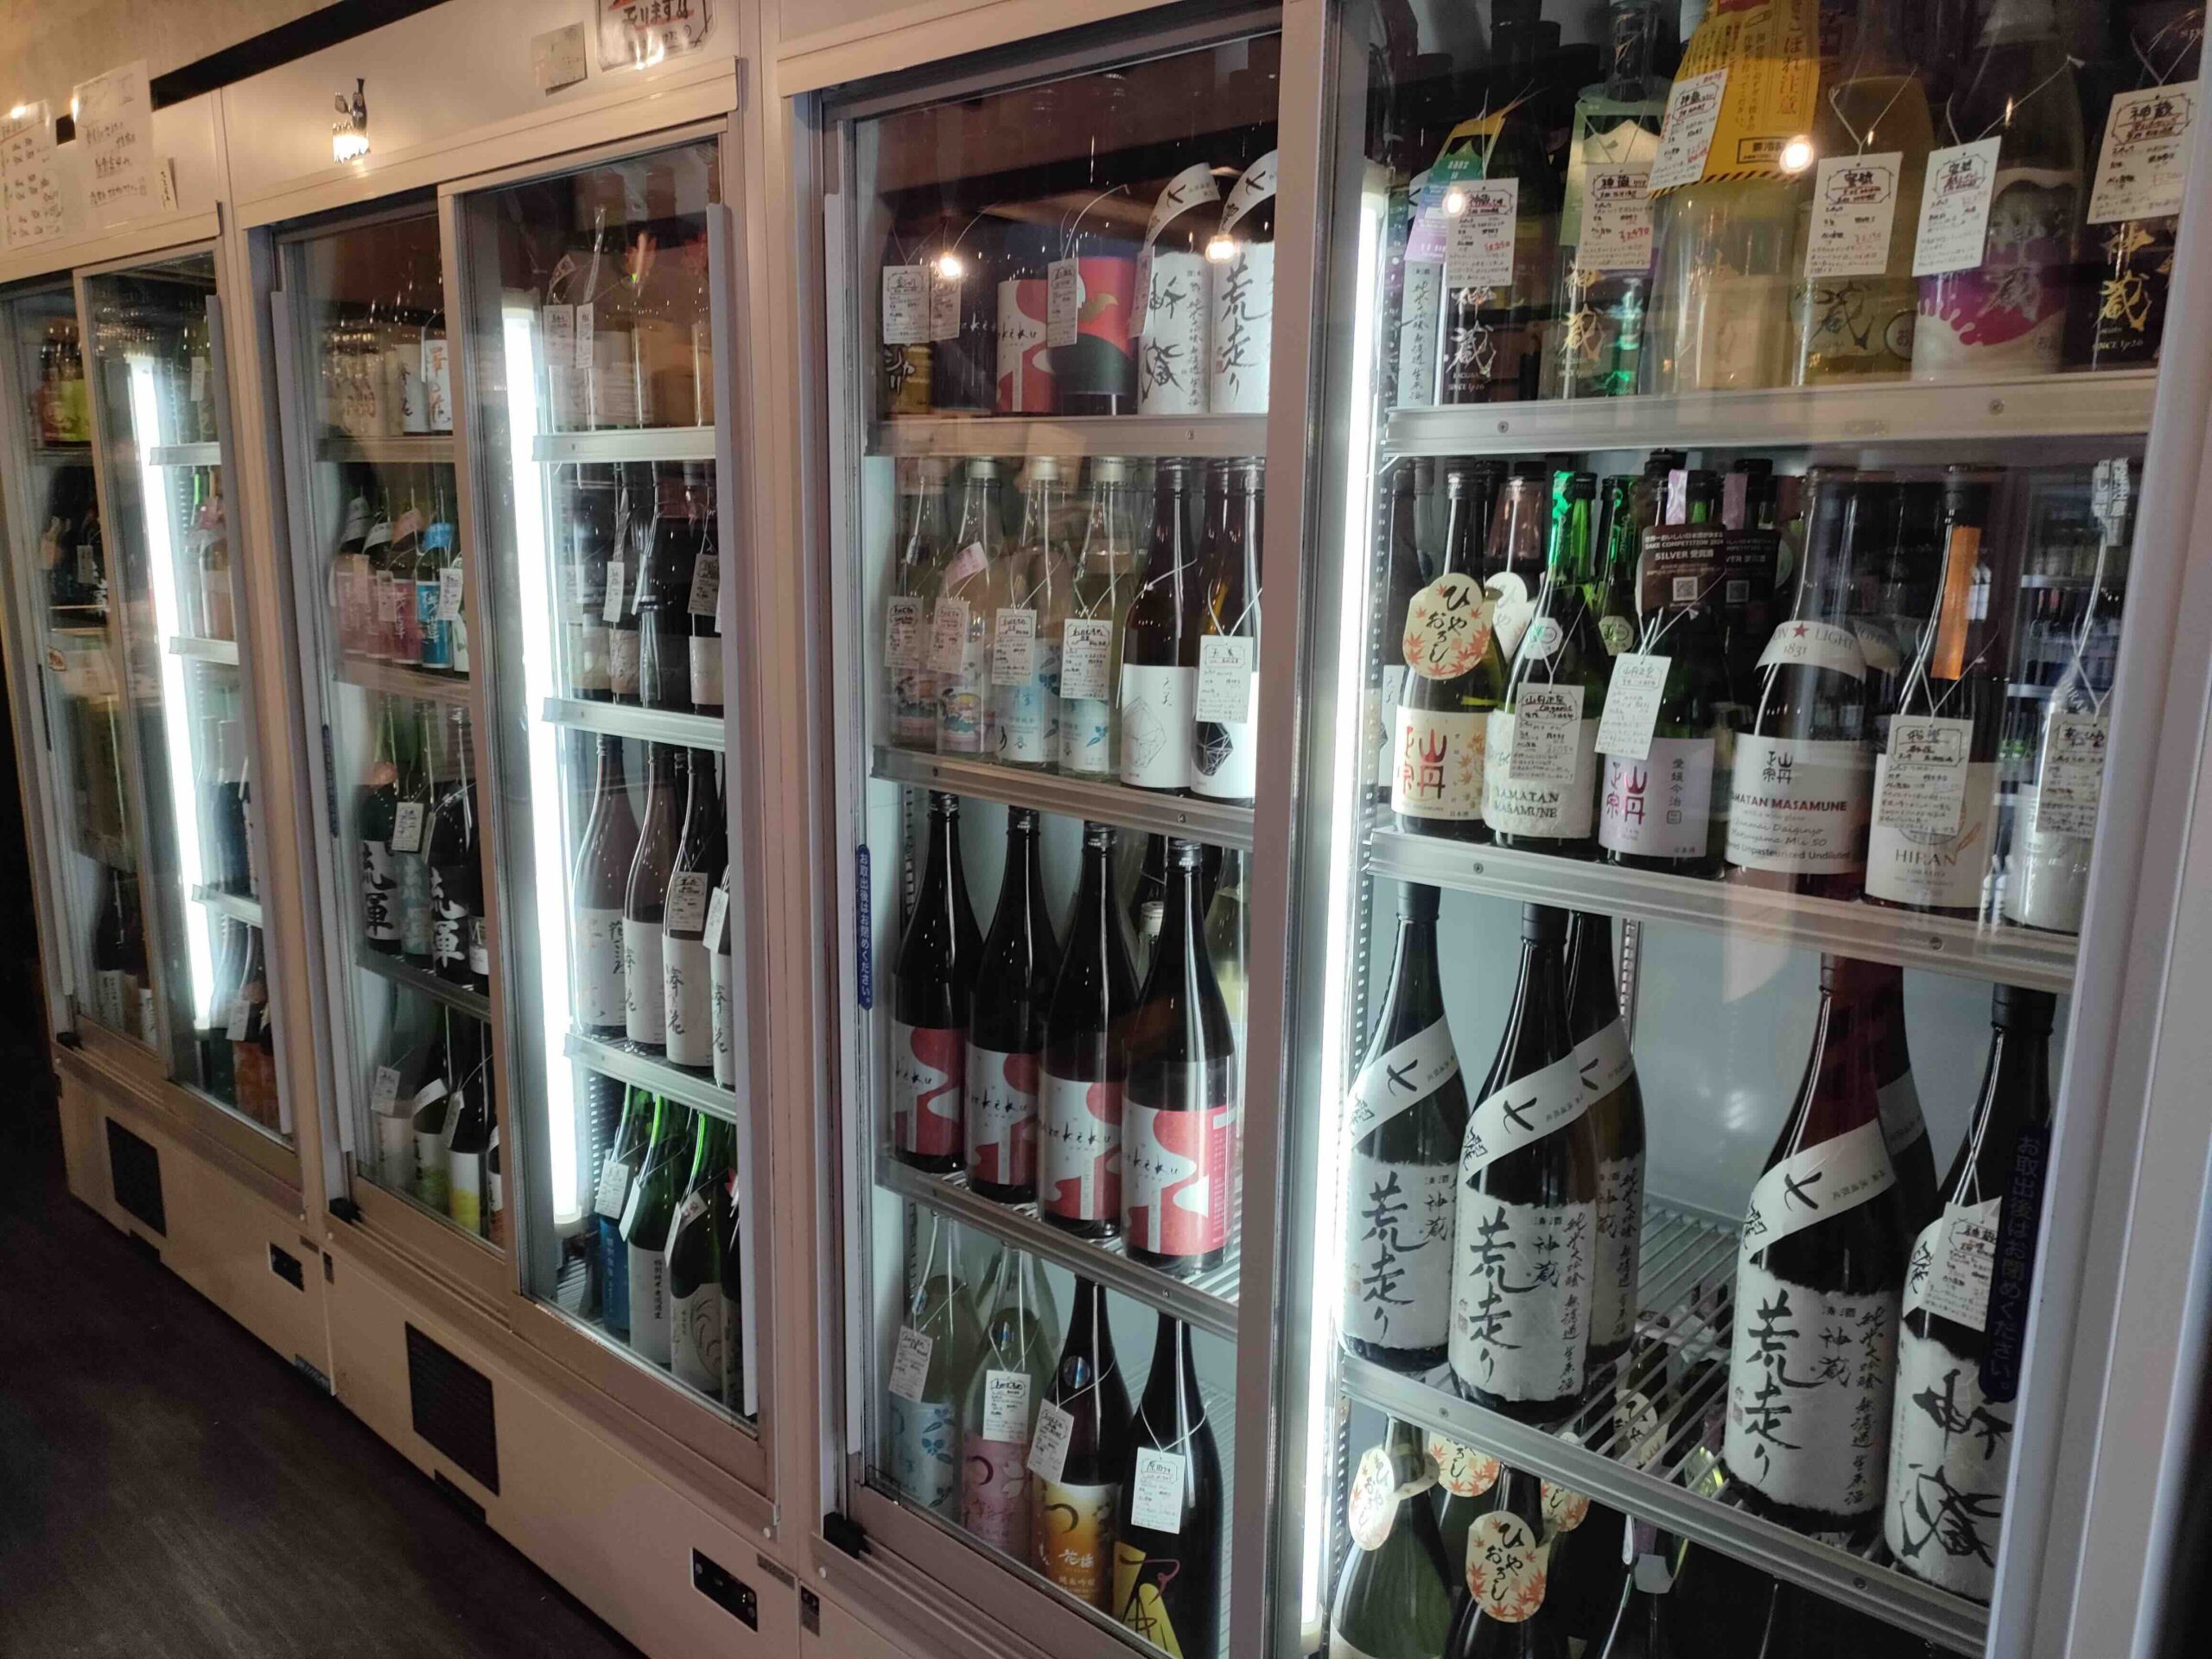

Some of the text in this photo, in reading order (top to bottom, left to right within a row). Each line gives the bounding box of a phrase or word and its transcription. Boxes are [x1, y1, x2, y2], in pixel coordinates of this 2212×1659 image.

[1771, 795, 1848, 813] MASAMUNE
[1360, 1170, 1432, 1343] 荒走り
[1469, 1206, 1541, 1386] 荒走り
[1745, 1288, 1827, 1486] 荒走り
